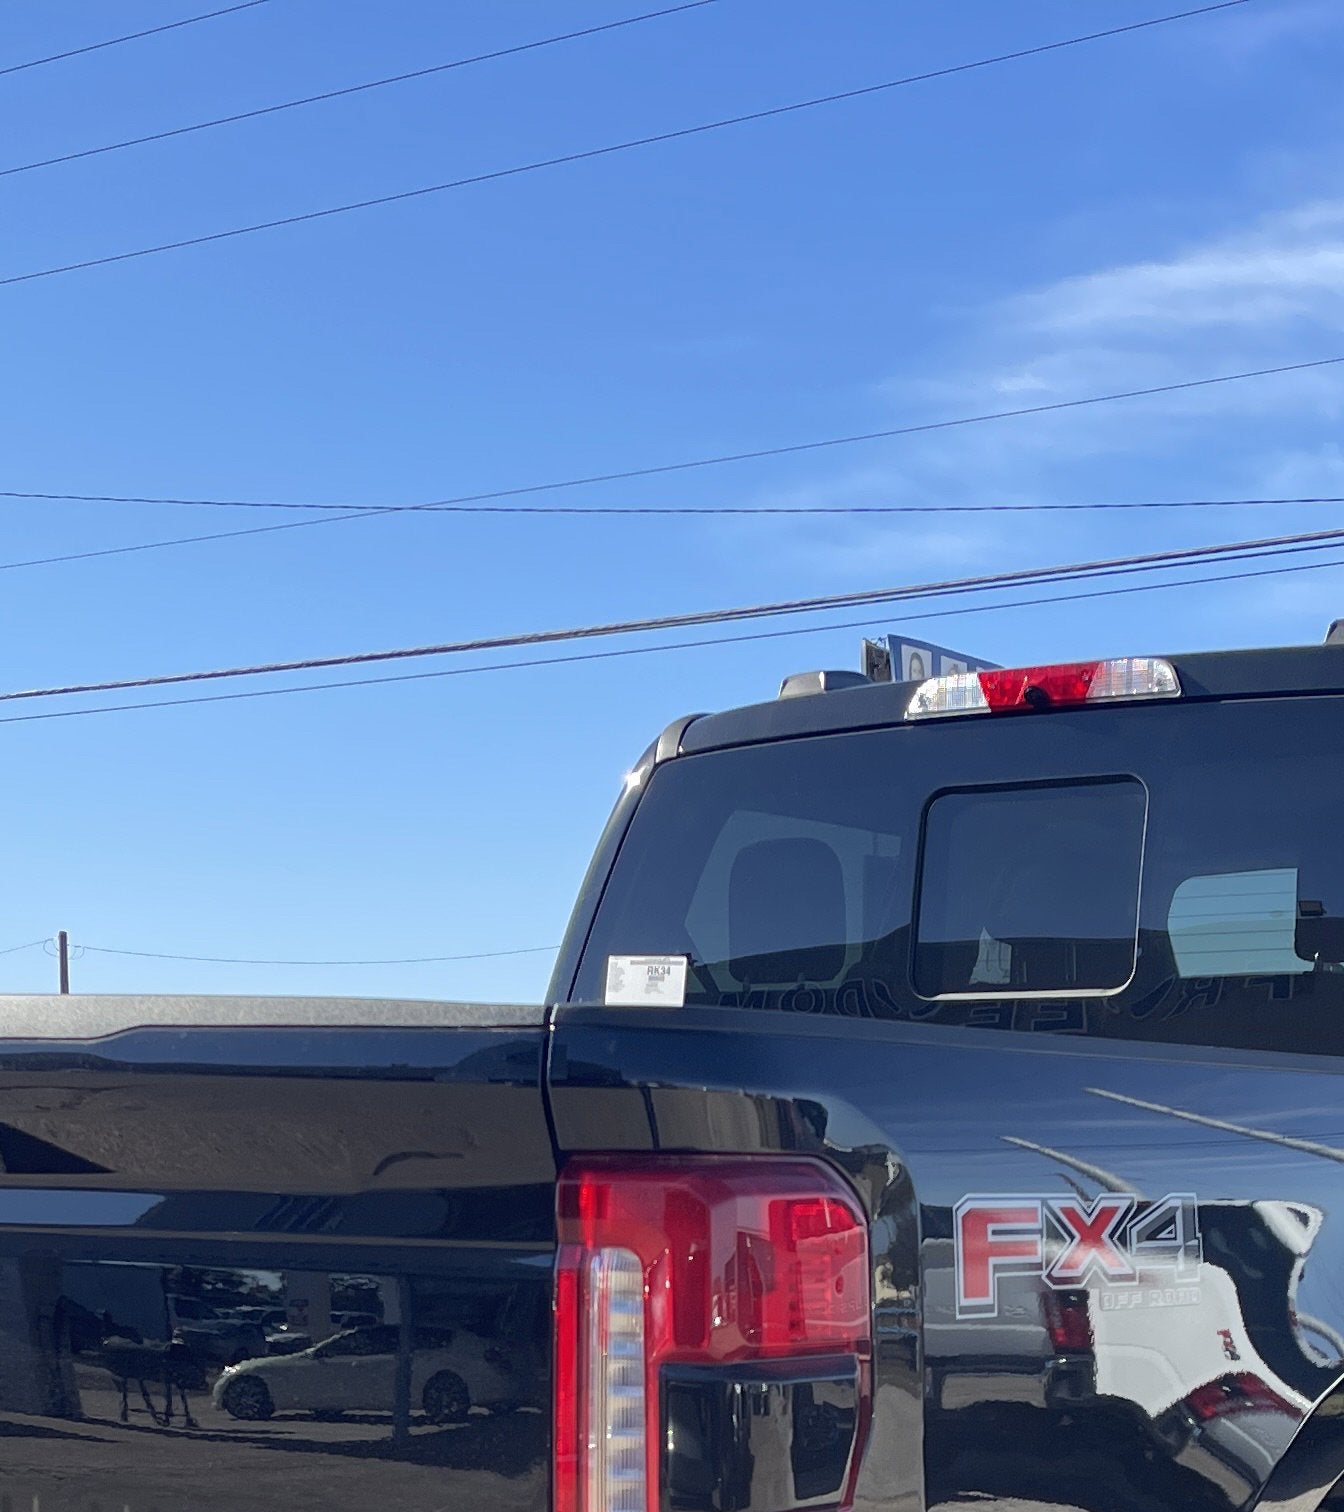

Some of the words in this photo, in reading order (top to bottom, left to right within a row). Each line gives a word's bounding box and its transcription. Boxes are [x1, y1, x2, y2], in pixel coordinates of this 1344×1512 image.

[952, 1192, 1204, 1320] FX4
[1099, 1290, 1145, 1311] OFF
[1148, 1286, 1202, 1309] ROAD
